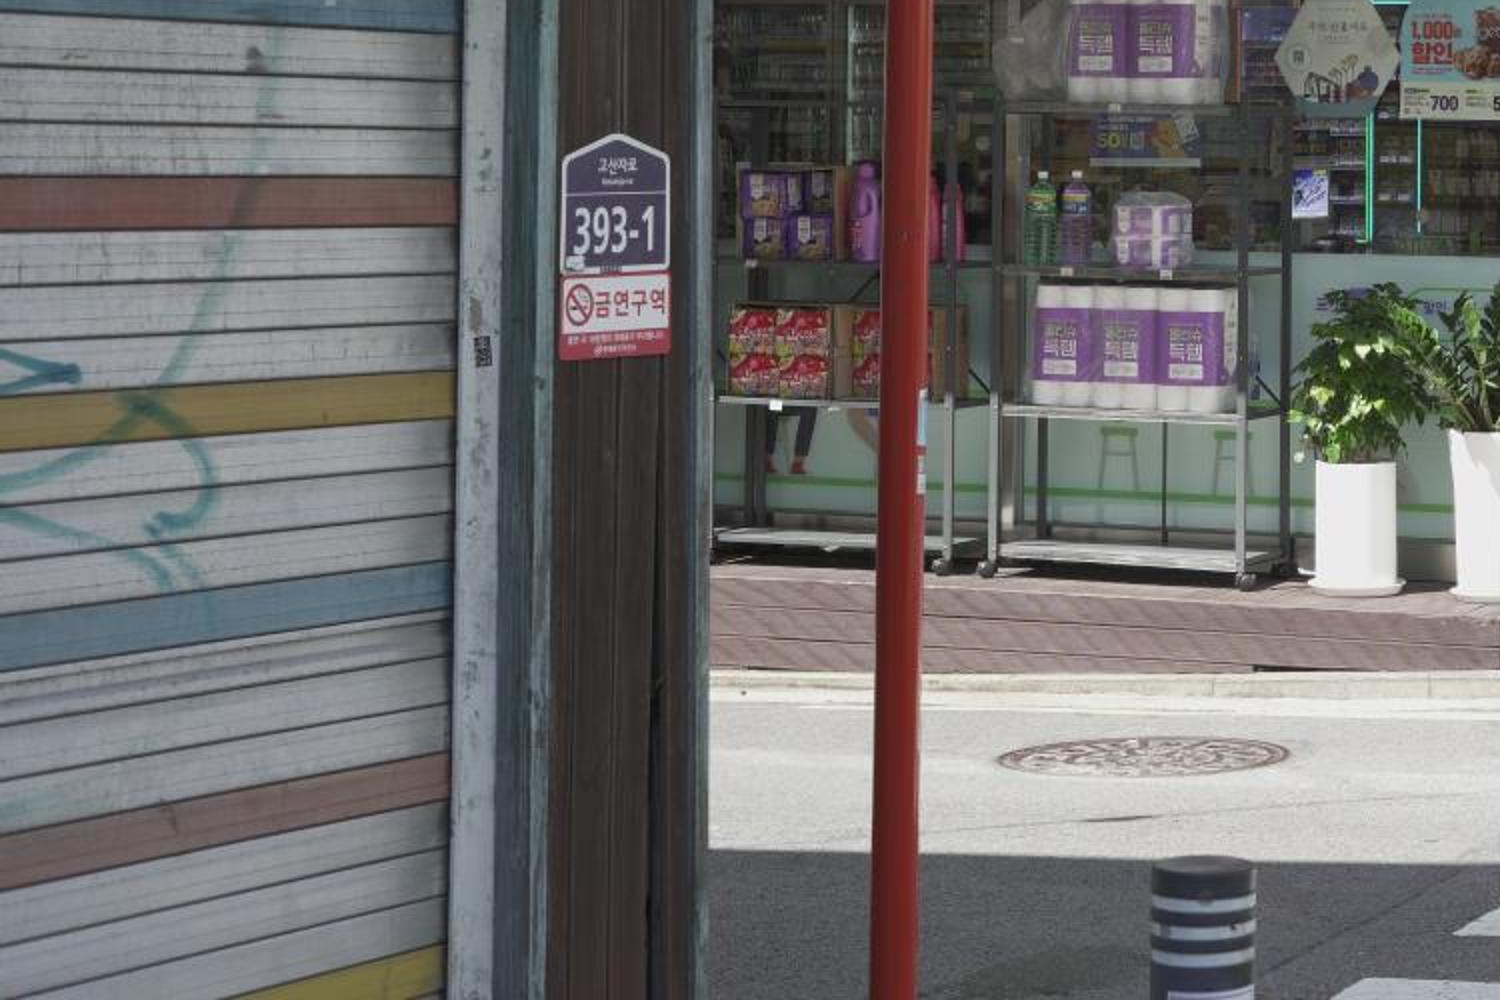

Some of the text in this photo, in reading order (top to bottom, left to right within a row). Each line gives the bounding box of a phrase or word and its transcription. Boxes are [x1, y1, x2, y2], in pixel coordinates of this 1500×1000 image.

[1411, 42, 1454, 65] 할인
[1430, 95, 1459, 111] 700
[597, 156, 638, 173] 고산자로
[573, 205, 656, 256] 393-1
[594, 288, 666, 318] 금연구역
